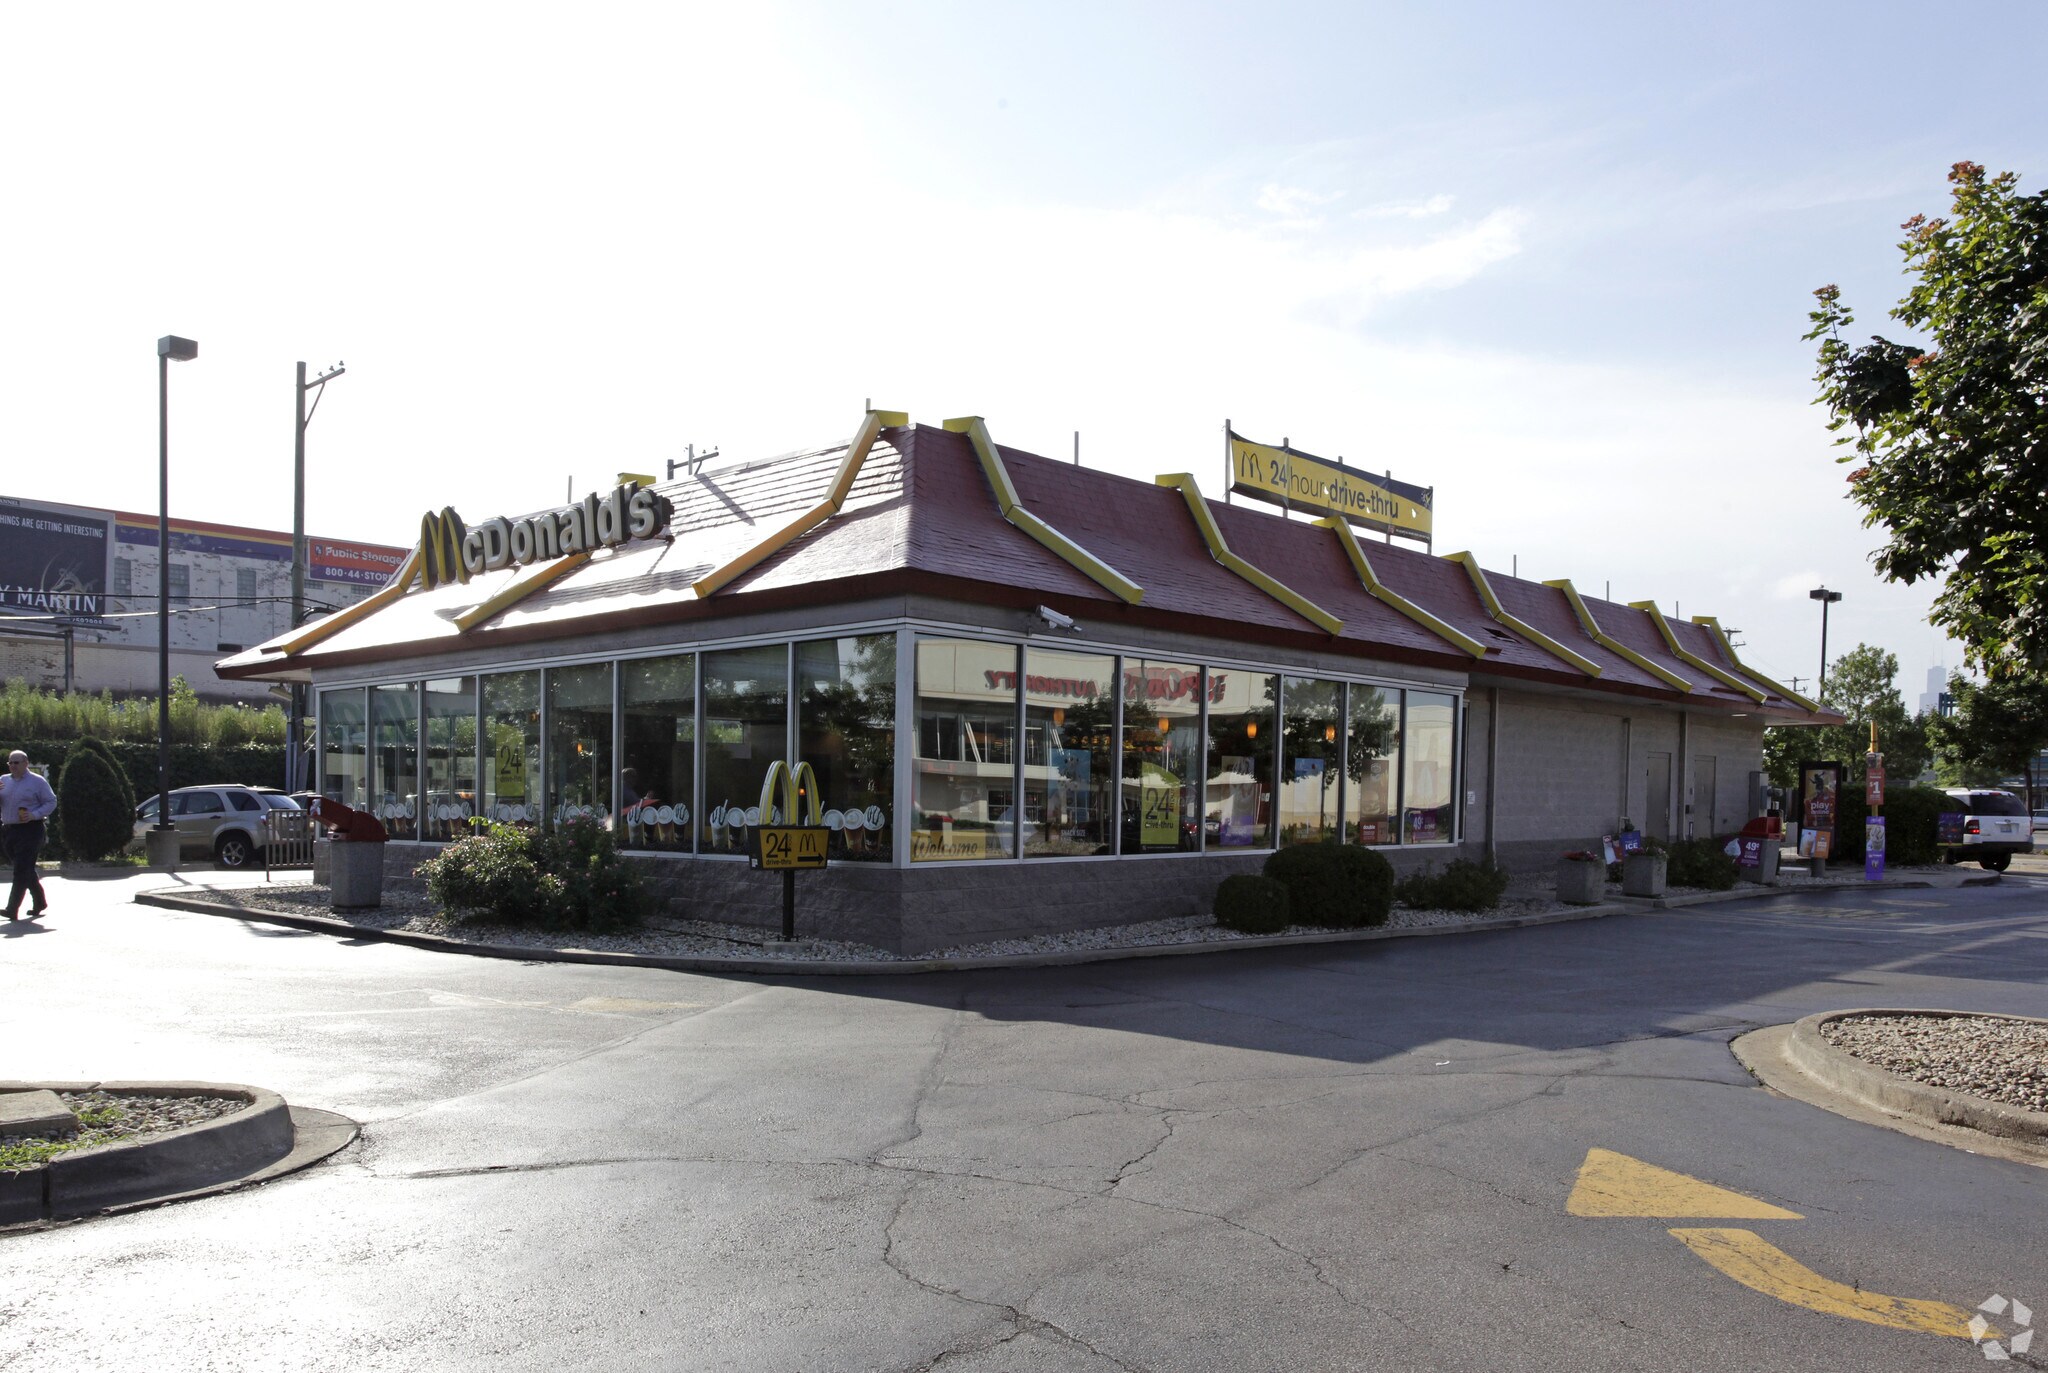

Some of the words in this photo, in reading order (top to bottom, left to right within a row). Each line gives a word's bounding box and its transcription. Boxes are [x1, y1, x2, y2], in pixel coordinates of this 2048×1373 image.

[1270, 460, 1288, 489] 24
[1290, 466, 1325, 499] hour
[1329, 477, 1399, 519] drive-thru
[21, 517, 34, 529] ARE
[35, 520, 62, 533] GETTING
[63, 524, 104, 538] INTERESTING
[419, 480, 674, 592] McDonald's
[325, 546, 359, 560] Public
[361, 551, 402, 567] Storage
[17, 586, 97, 613] MARTIN
[500, 744, 522, 775] 24
[1145, 787, 1169, 820] 24
[1810, 801, 1830, 811] play
[765, 832, 792, 859] 24
[911, 834, 978, 859] Welcome
[1625, 842, 1639, 851] ICE
